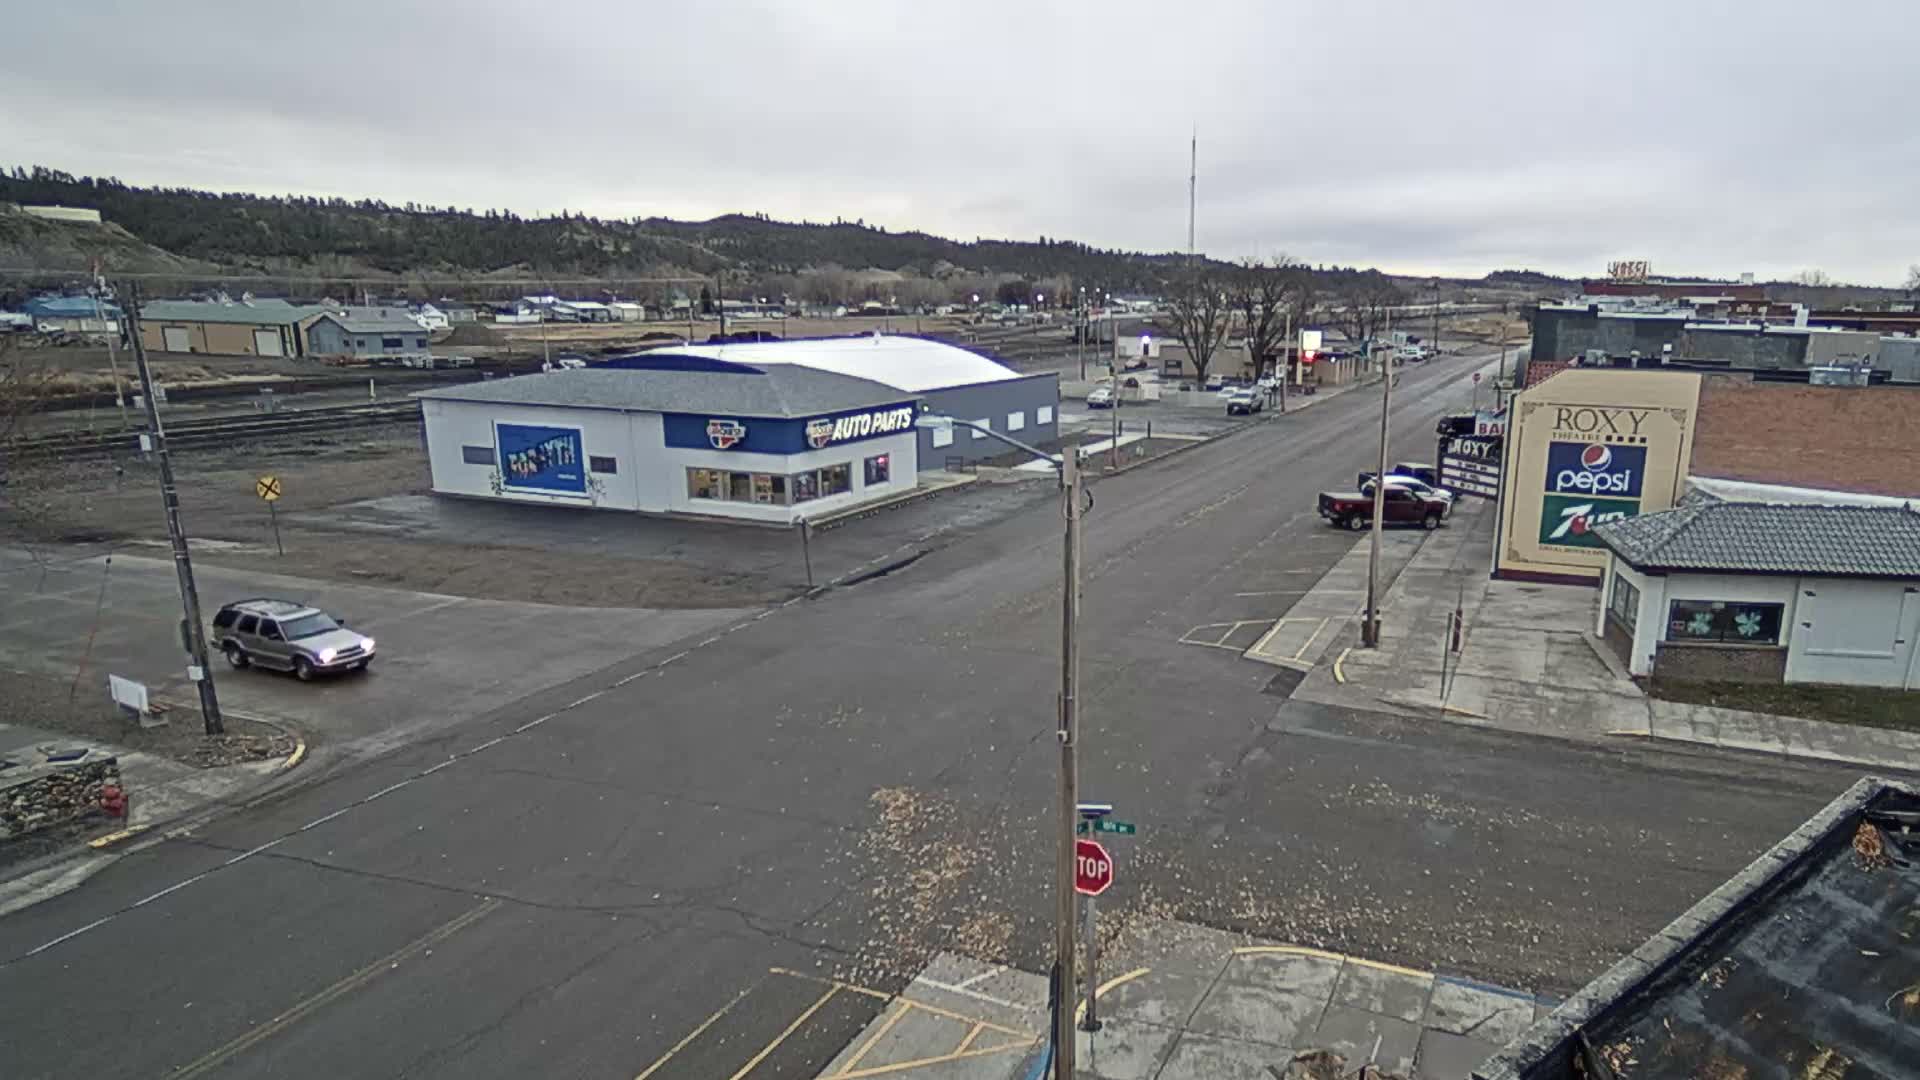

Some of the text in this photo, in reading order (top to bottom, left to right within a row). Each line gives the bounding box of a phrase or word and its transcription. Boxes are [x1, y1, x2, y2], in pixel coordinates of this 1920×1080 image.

[832, 413, 871, 441] AUTO
[871, 407, 912, 434] PARTS
[1552, 407, 1649, 434] ROXY
[1447, 439, 1494, 459] ROXY
[1556, 469, 1631, 495] pepsi
[1078, 856, 1107, 880] TOP
